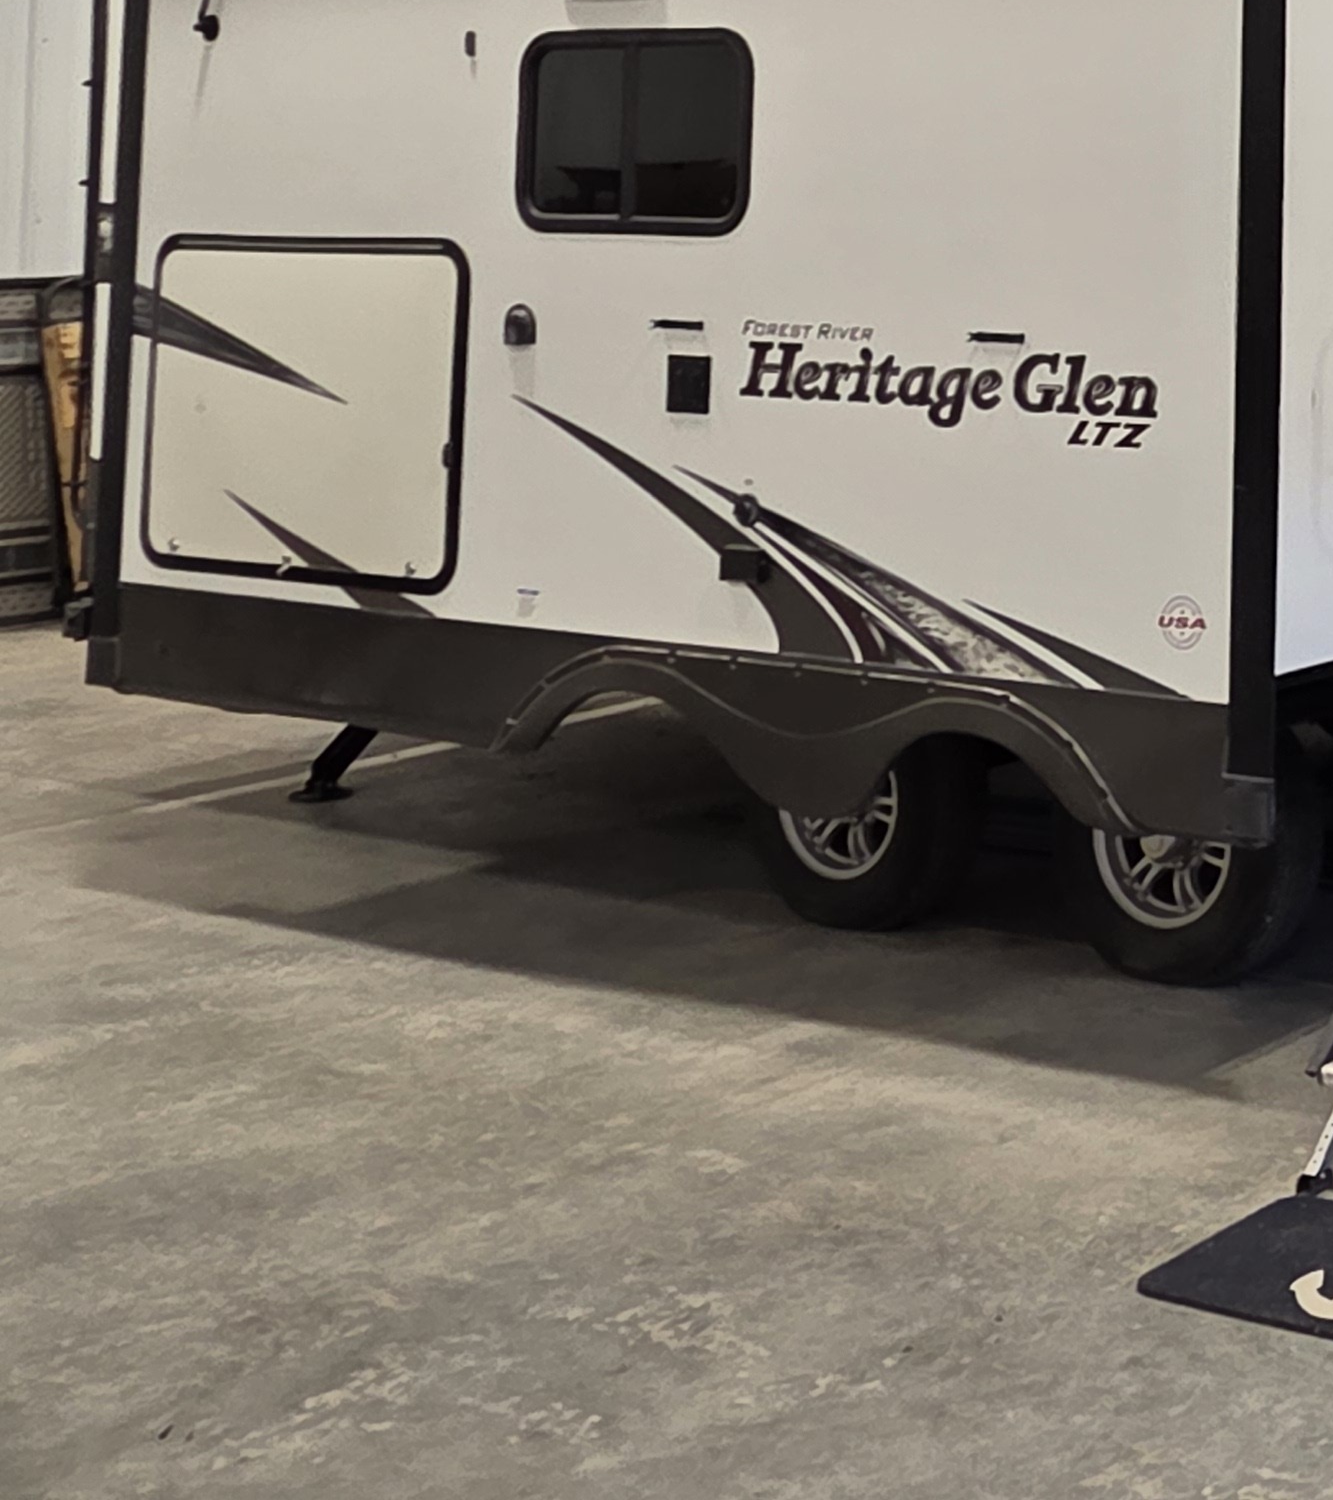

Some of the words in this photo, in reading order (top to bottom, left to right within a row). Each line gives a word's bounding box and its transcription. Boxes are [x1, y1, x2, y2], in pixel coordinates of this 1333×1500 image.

[742, 319, 814, 339] FOREST
[817, 323, 875, 341] RIVER
[739, 341, 1003, 428] Heritage
[1013, 353, 1158, 418] Glen
[1067, 420, 1151, 449] LTZ
[1158, 615, 1206, 630] USA
